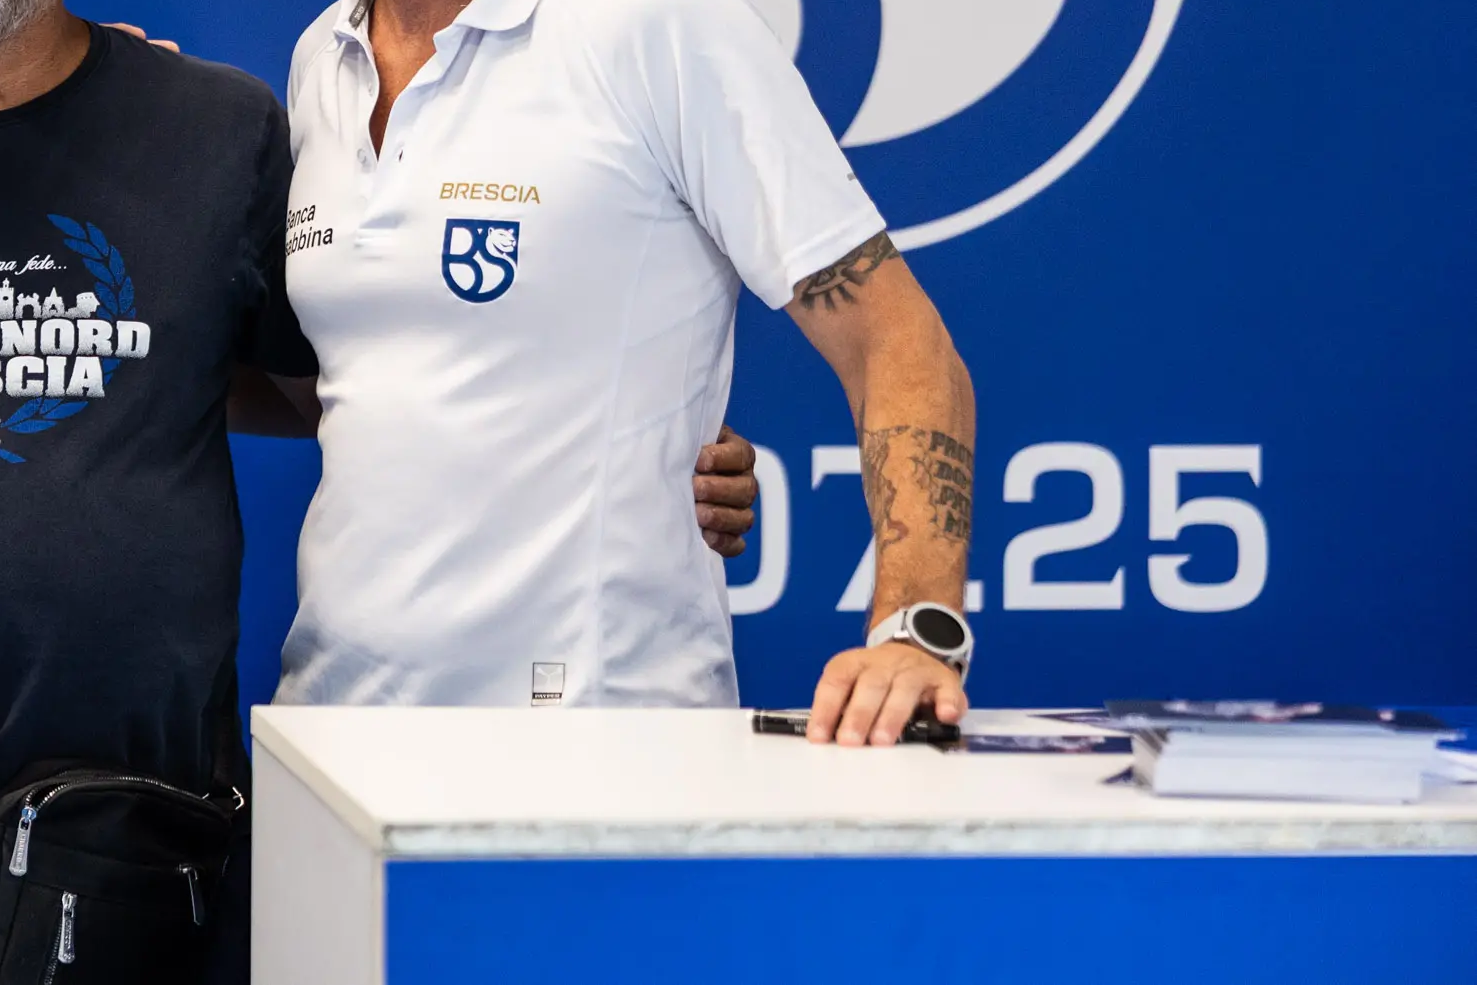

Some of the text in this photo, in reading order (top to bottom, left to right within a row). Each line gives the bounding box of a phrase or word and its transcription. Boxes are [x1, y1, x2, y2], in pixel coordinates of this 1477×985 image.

[439, 183, 541, 204] BRESCIA
[14, 254, 67, 276] fede...
[0, 318, 151, 359] NORD
